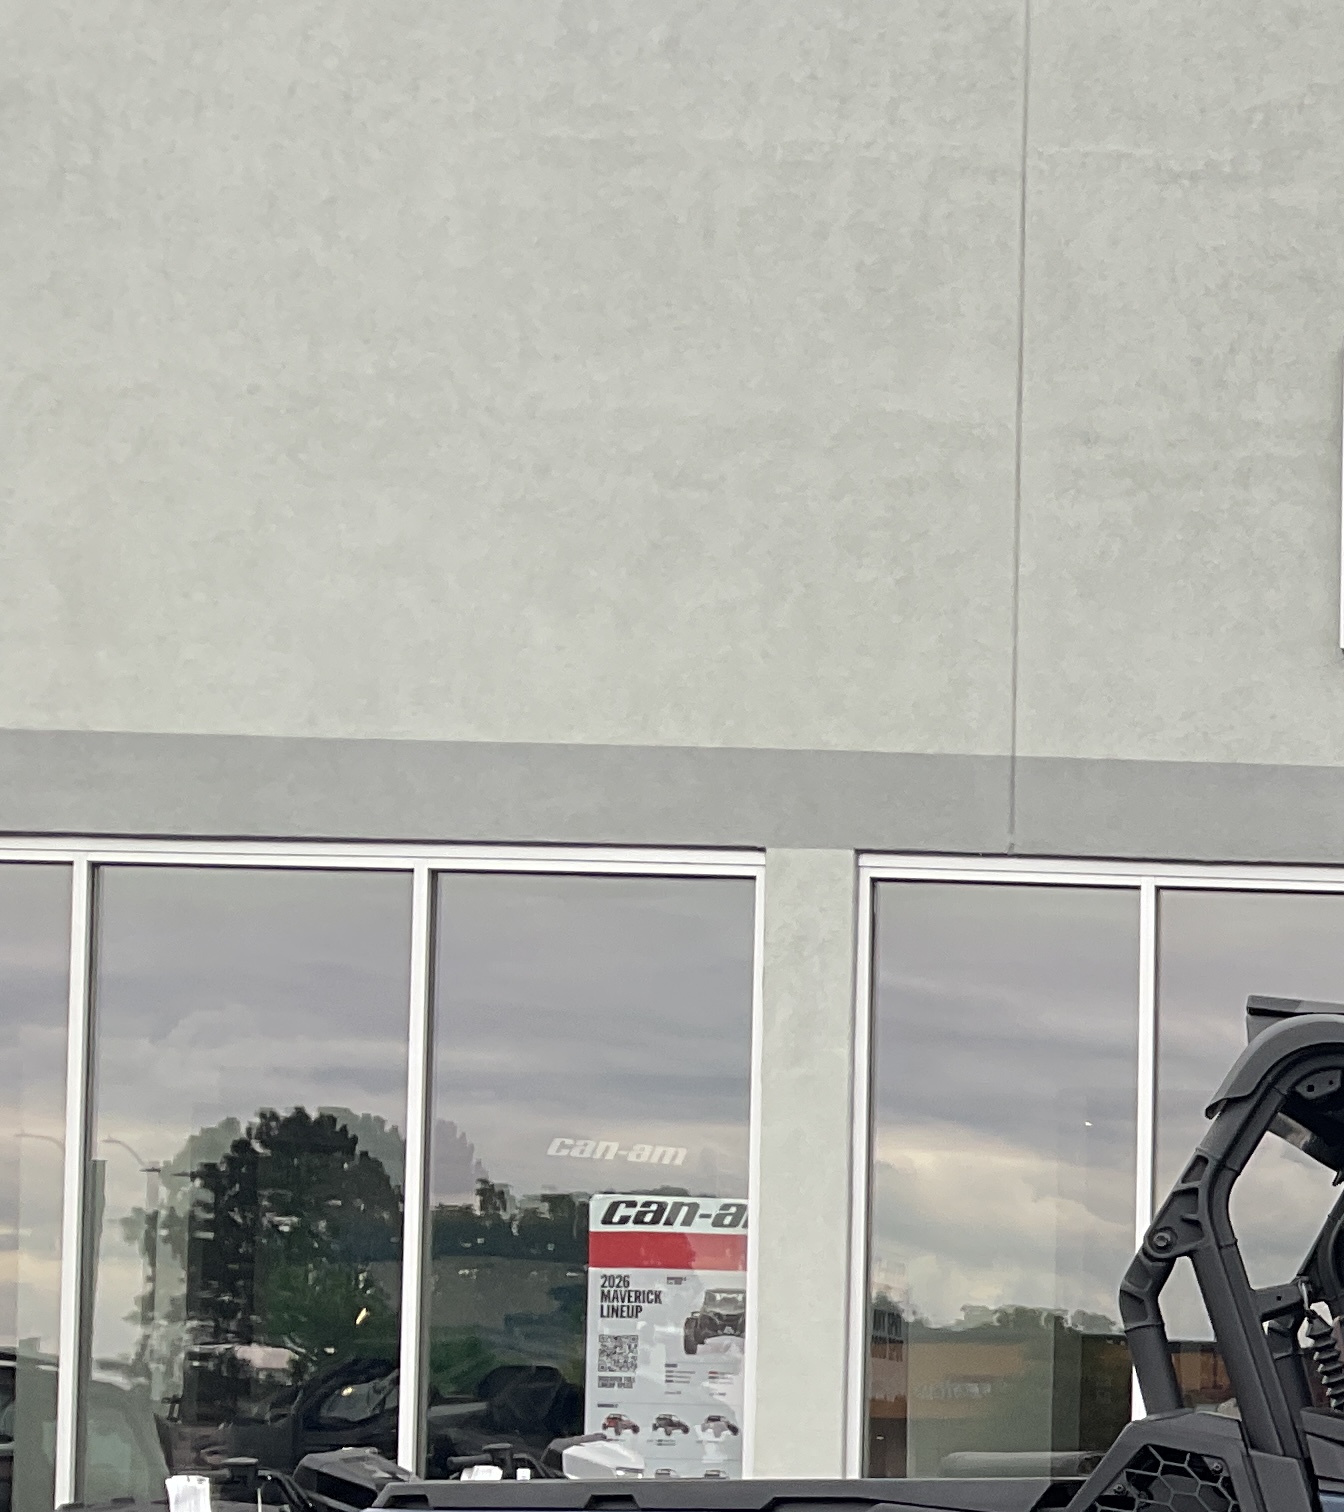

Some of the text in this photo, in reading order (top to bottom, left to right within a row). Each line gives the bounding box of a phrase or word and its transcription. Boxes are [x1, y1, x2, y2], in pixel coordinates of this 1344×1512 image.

[547, 1137, 688, 1166] can-am
[600, 1274, 631, 1289] 2026
[600, 1289, 663, 1304] MAVERICK
[600, 1304, 643, 1319] LINEUP
